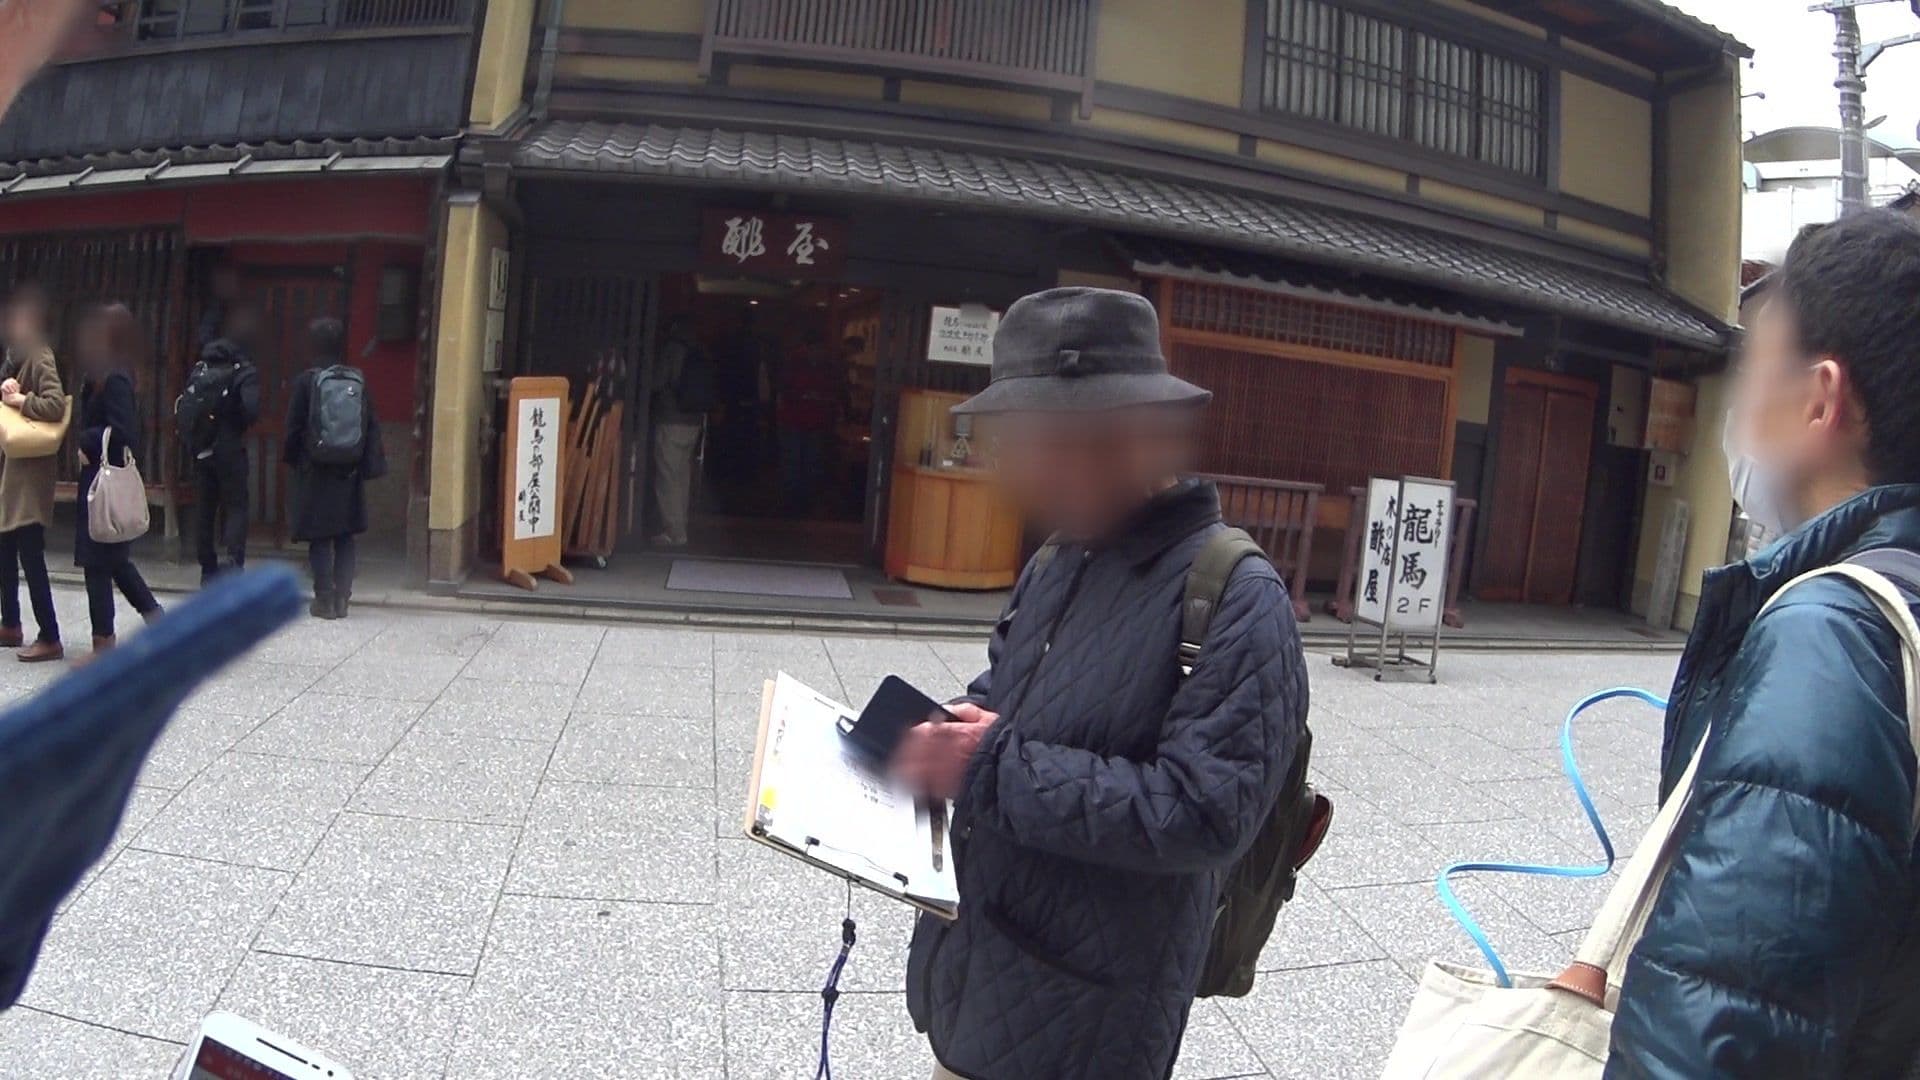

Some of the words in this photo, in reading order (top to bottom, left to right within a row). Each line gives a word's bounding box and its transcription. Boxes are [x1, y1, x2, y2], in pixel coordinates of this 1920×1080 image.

[1365, 521, 1384, 604] 酢屋
[1380, 496, 1397, 566] 木の店
[1399, 504, 1434, 590] 龍馬
